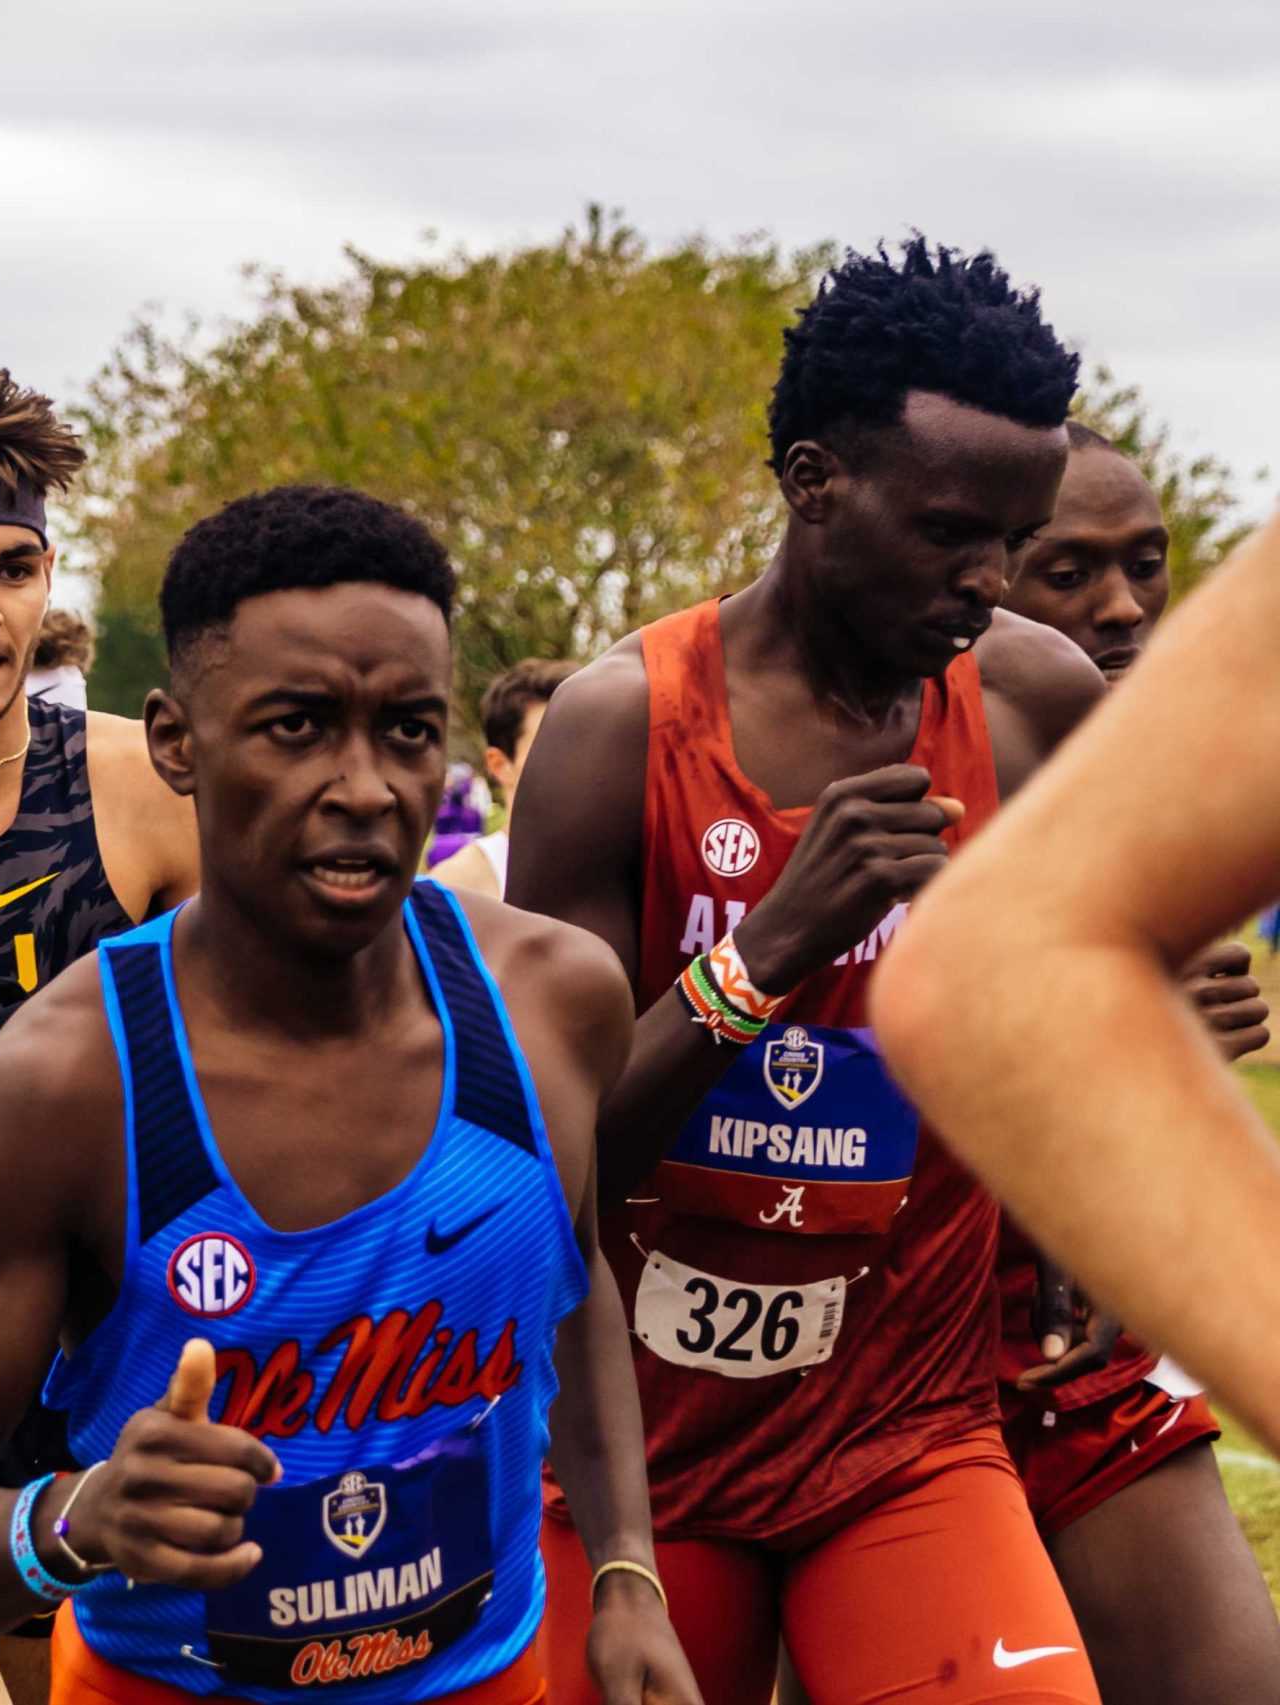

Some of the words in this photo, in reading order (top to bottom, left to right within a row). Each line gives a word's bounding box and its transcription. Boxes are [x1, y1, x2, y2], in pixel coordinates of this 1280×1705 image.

[705, 822, 756, 873] SEC
[709, 1115, 867, 1167] KIPSANG
[176, 1238, 249, 1313] SEC
[675, 1277, 804, 1362] 326
[314, 1300, 523, 1433] Miss
[269, 1547, 443, 1627] SULIMAN
[291, 1641, 350, 1685] Ole
[349, 1629, 433, 1675] Miss
